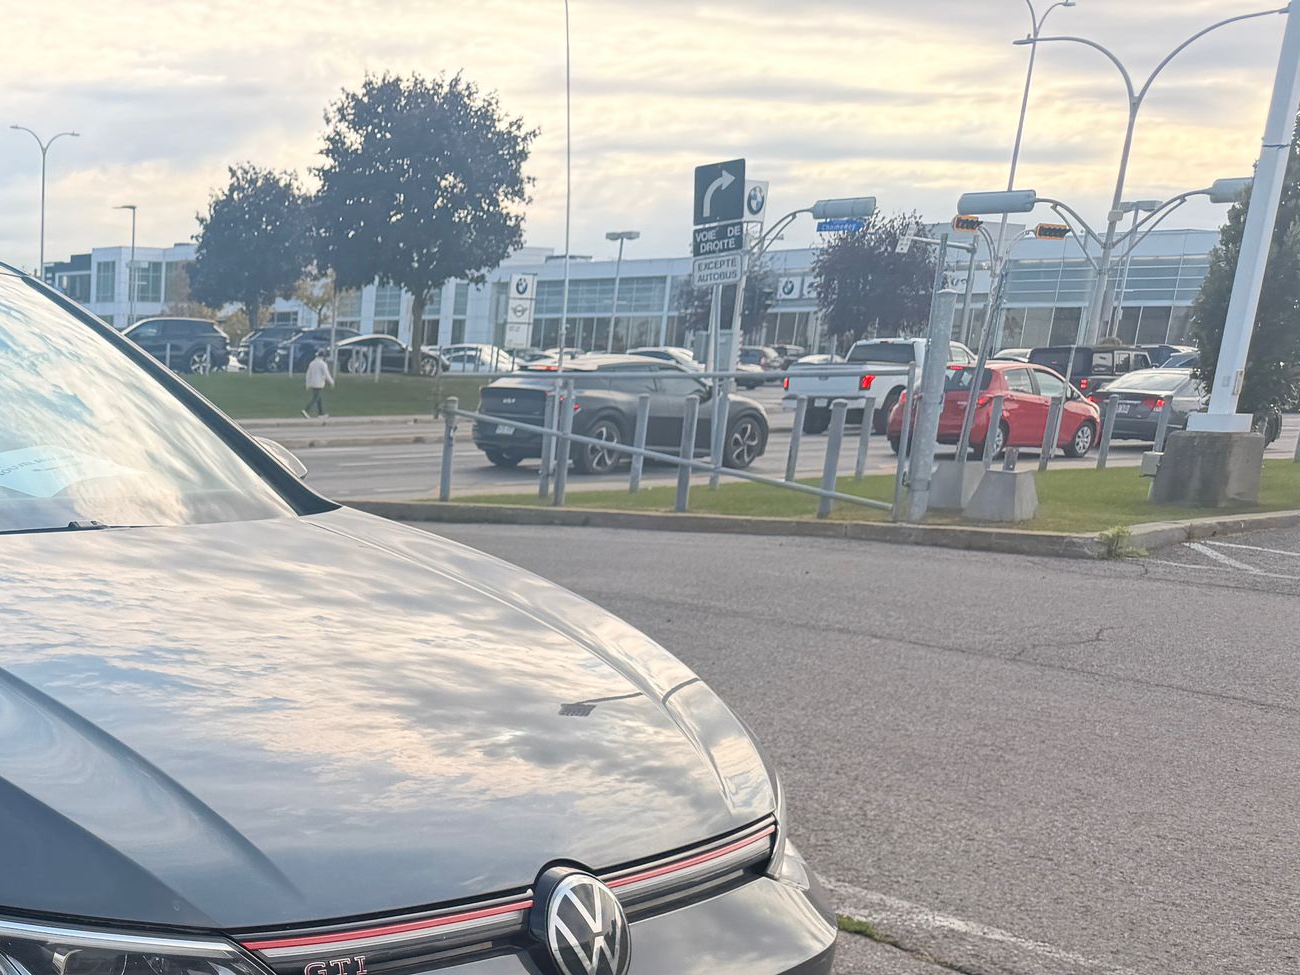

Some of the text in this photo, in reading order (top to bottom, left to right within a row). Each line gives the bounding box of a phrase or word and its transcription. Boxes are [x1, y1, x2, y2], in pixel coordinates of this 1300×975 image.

[695, 225, 741, 243] VOIE DE
[700, 238, 736, 253] DROITE
[698, 271, 737, 282] AUTOBUS
